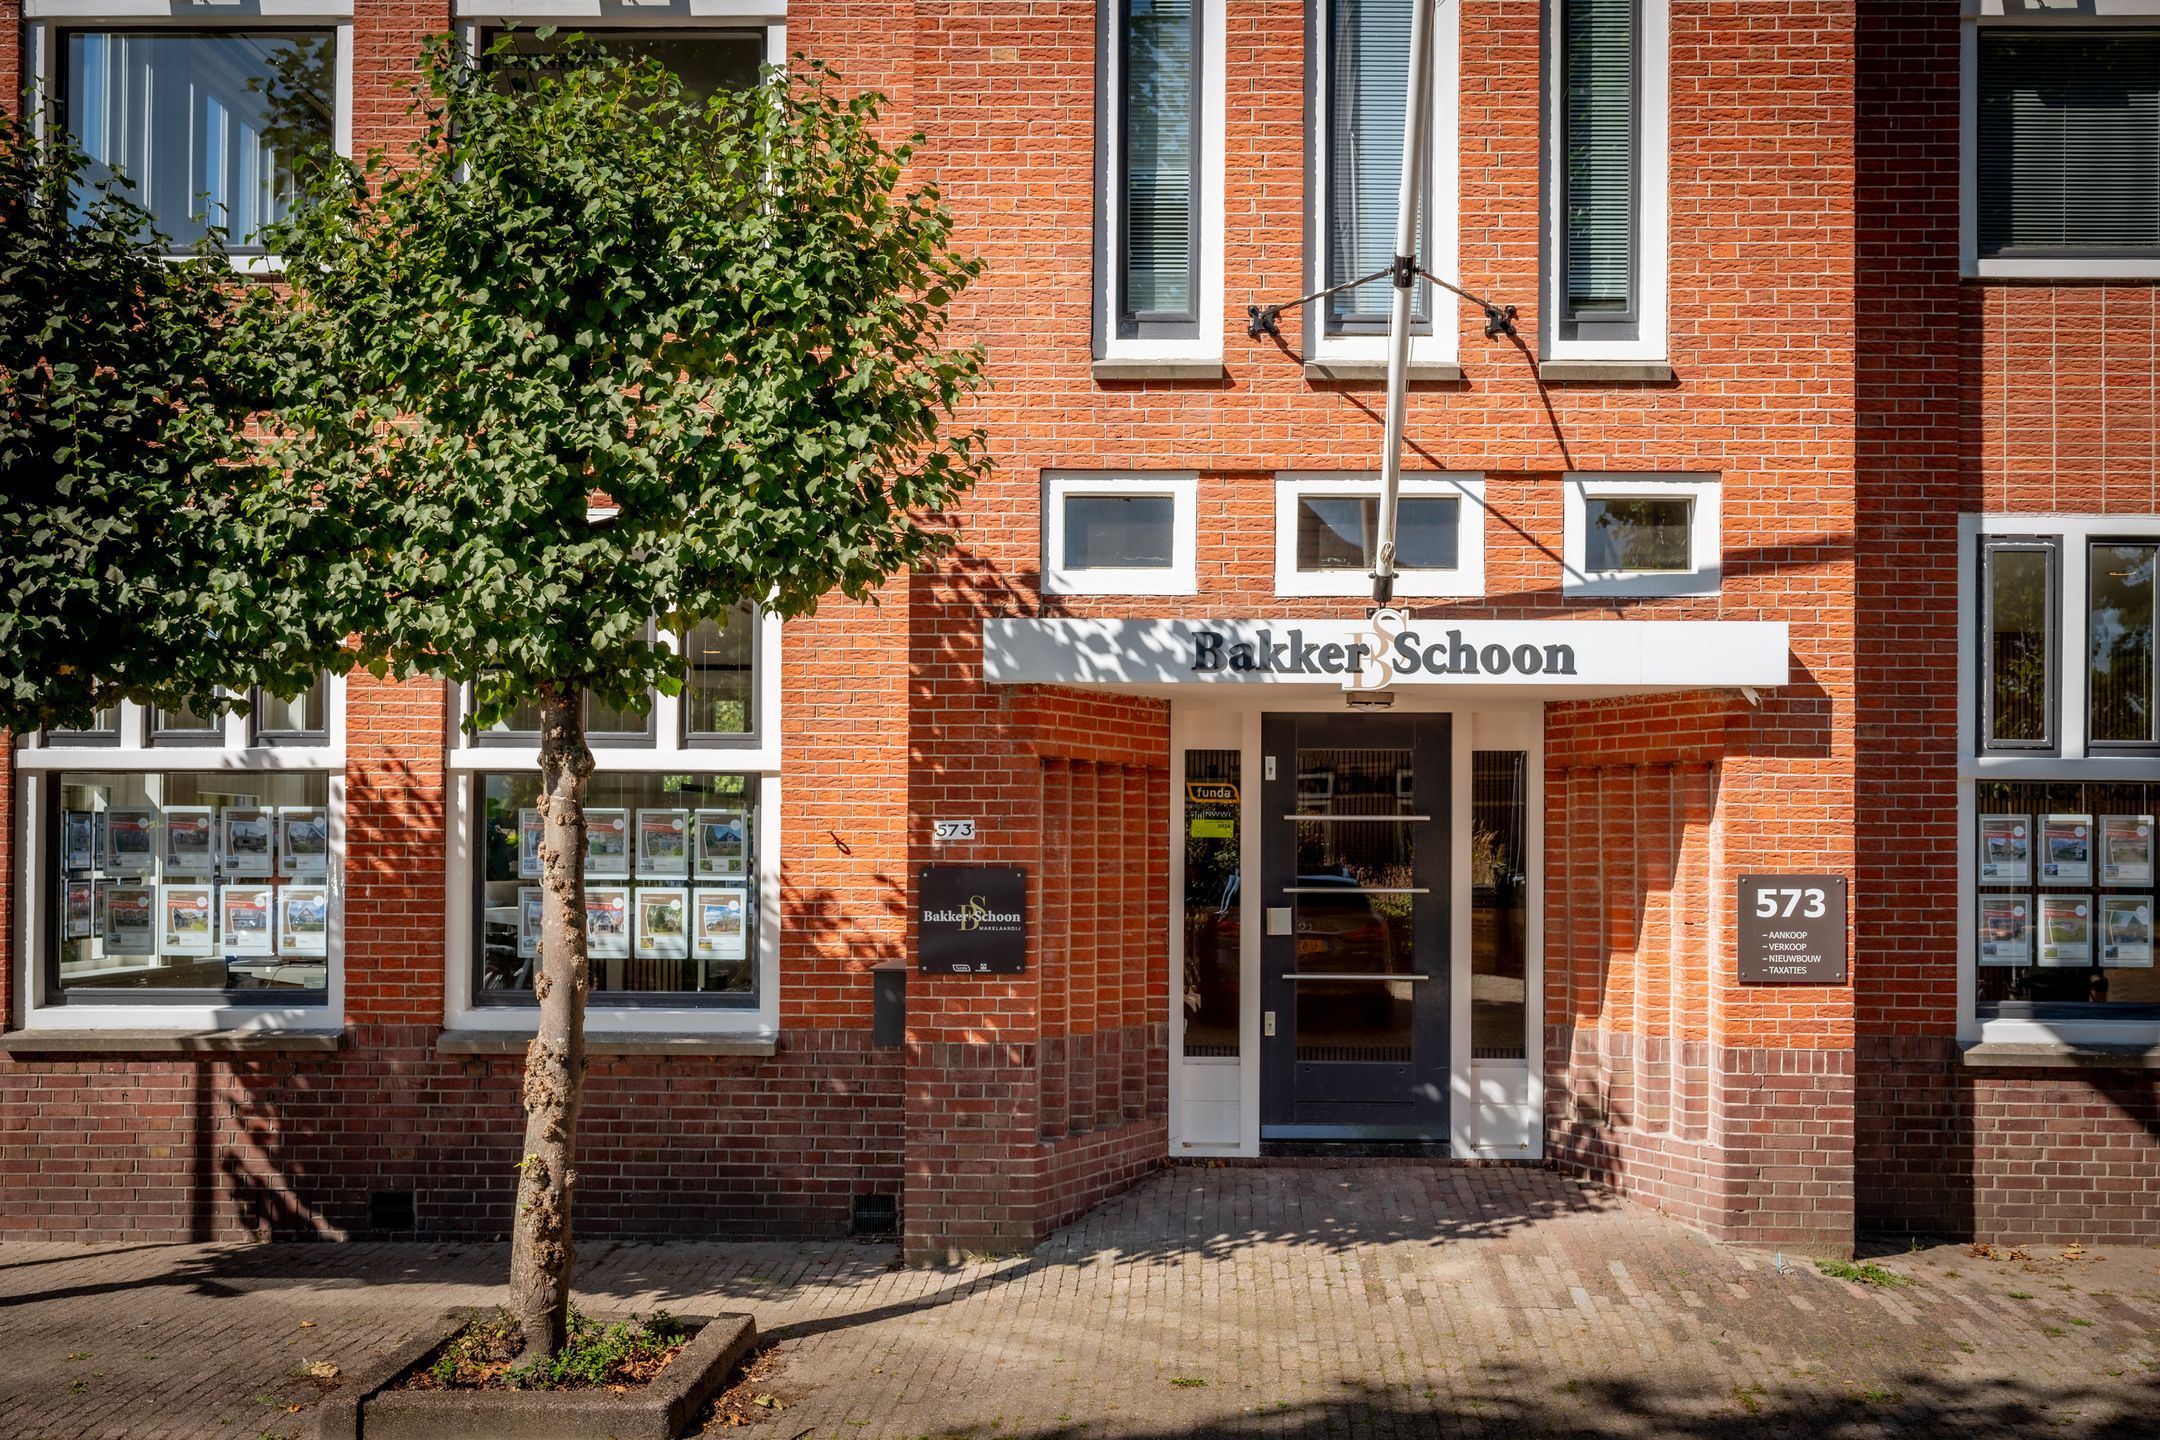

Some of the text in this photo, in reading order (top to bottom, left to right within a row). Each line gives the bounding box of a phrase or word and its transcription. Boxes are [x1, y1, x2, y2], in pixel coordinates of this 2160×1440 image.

[1191, 629, 1577, 675] Bakker Schoon
[1196, 787, 1231, 798] funda
[936, 824, 972, 836] 573
[1756, 888, 1826, 918] 573
[923, 910, 1021, 923] Bakker Schoon
[1769, 931, 1808, 940] AANKOOP
[1769, 943, 1807, 951] VERKOOP
[1769, 954, 1821, 963] NIEUWBOUW
[1769, 966, 1807, 974] TAXATIES
